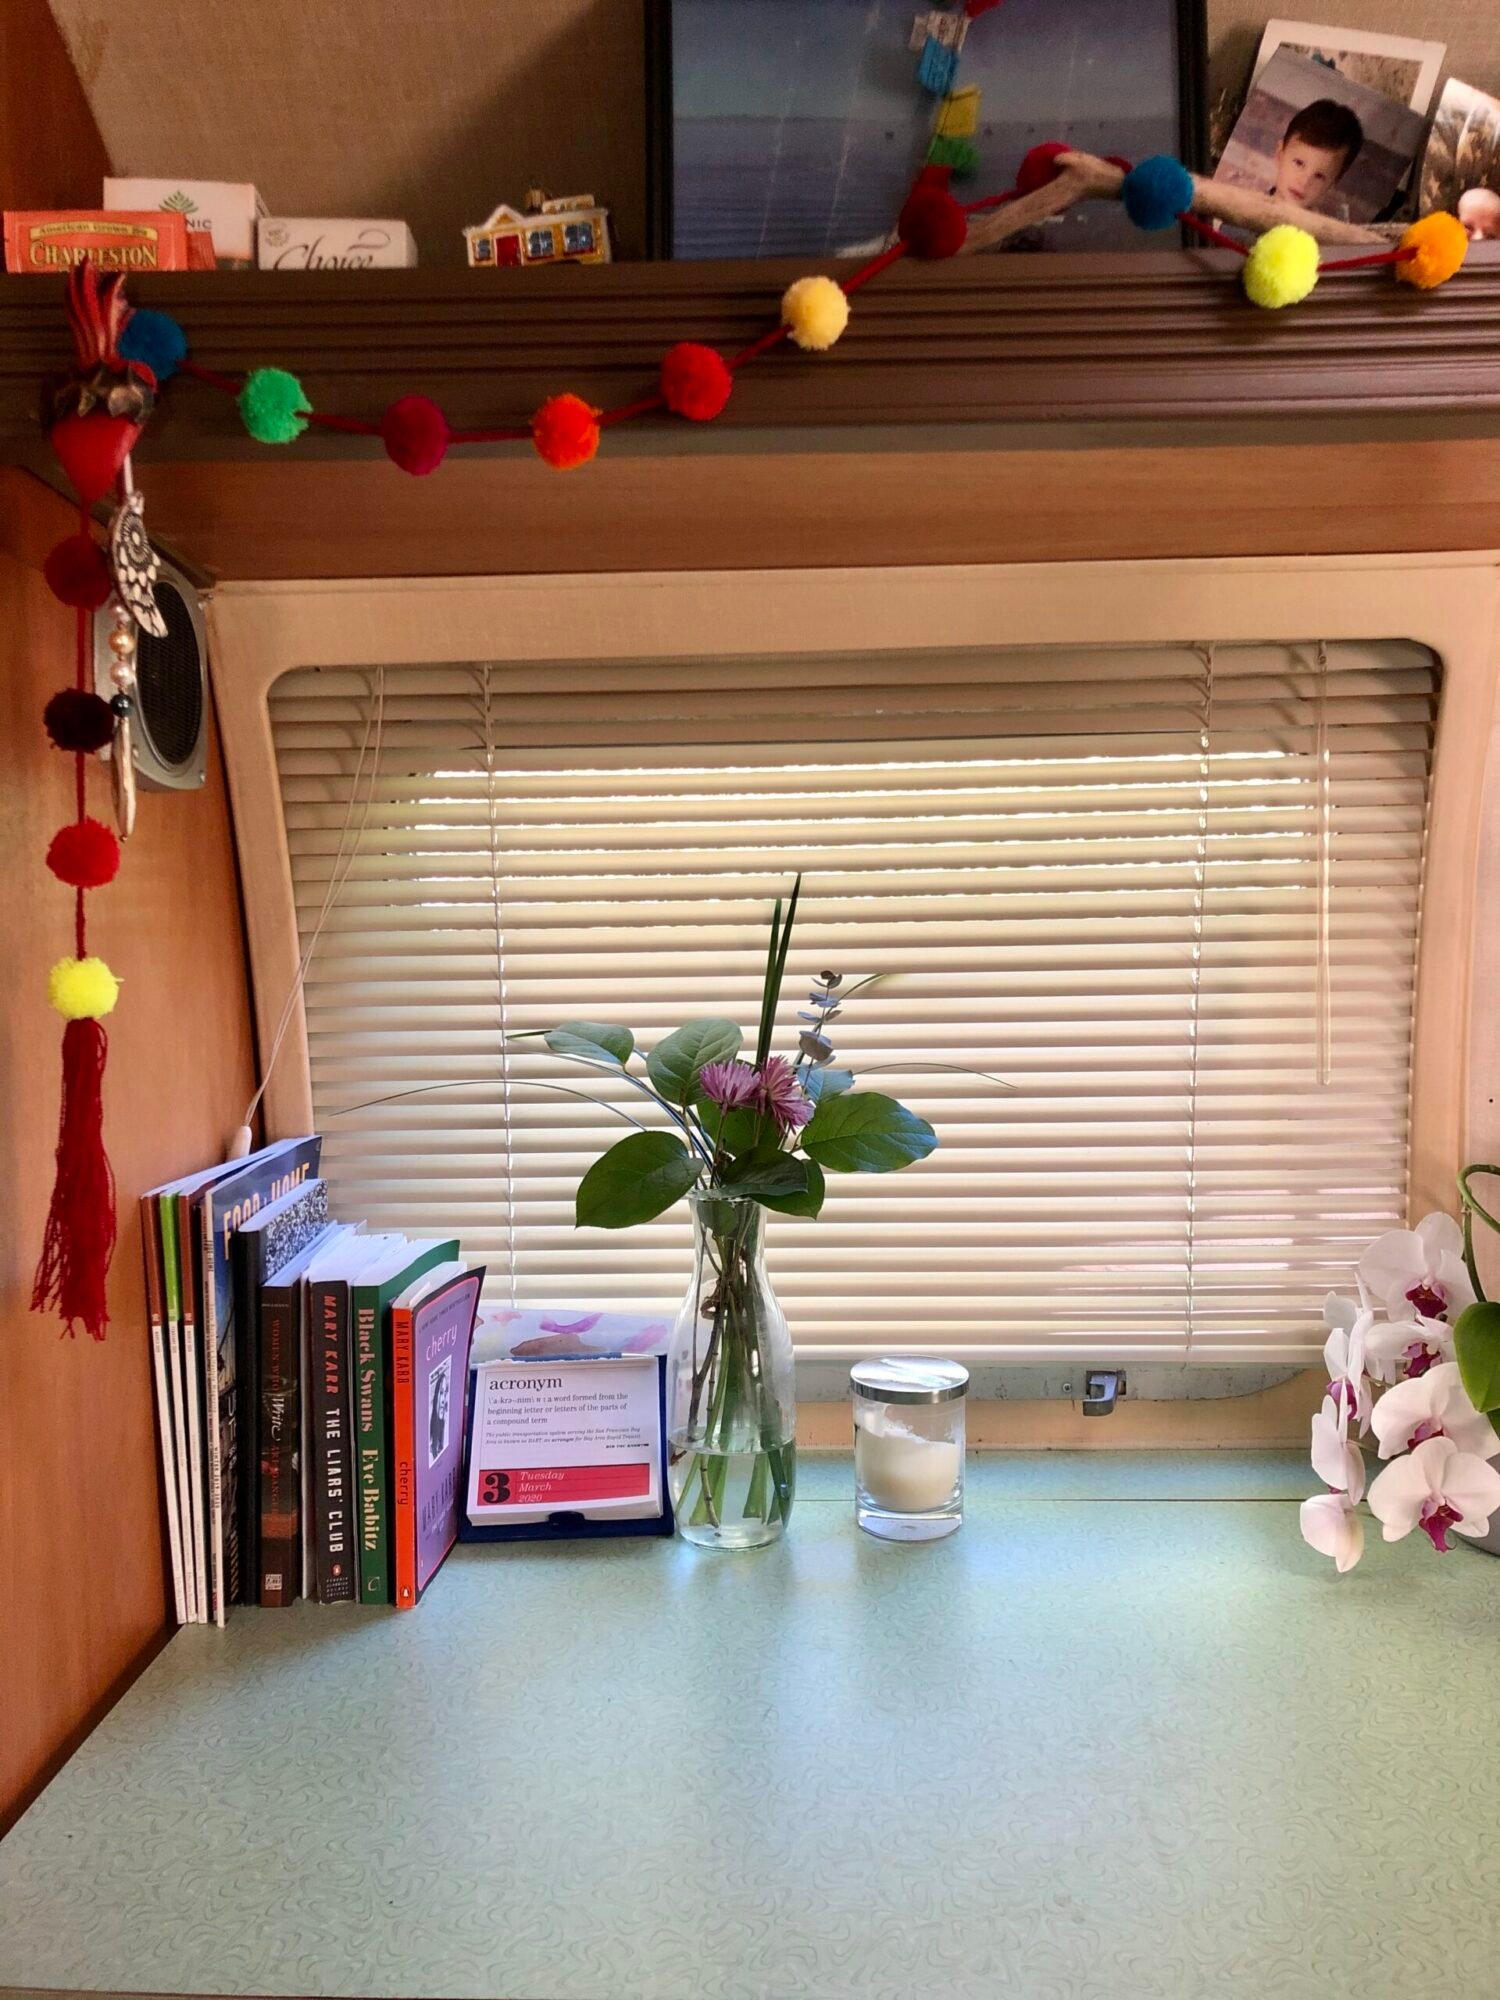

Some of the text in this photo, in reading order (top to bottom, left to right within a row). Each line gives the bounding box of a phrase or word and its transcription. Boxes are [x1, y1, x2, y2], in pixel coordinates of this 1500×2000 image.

[30, 240, 158, 268] CHARLESTON
[273, 229, 391, 270] Choice
[271, 1319, 280, 1361] WOMEN
[323, 1295, 339, 1394] MARY KARR
[395, 1321, 410, 1384] MARY KARR
[425, 1323, 458, 1361] cherry
[271, 1364, 280, 1392] WHO
[358, 1308, 376, 1432] Black Swans
[489, 1377, 563, 1392] acronym
[487, 1406, 523, 1416] beginning
[524, 1405, 543, 1414] letter
[554, 1404, 577, 1413] letters
[578, 1403, 586, 1412] of
[587, 1403, 599, 1412] the
[600, 1403, 618, 1413] parts
[619, 1402, 628, 1411] of
[553, 1394, 571, 1402] word
[572, 1393, 597, 1402] formed
[599, 1392, 615, 1401] from
[616, 1392, 628, 1400] the
[271, 1397, 285, 1441] Write
[492, 1416, 530, 1426] compound
[531, 1416, 548, 1424] term
[326, 1408, 344, 1553] THE LIARS' CLUB
[362, 1449, 380, 1551] Eve Babitz
[397, 1461, 412, 1505] cherry
[483, 1471, 565, 1504] 3 Tuesday
[518, 1494, 543, 1503] 2020
[519, 1482, 552, 1493] March
[422, 1488, 440, 1533] MARY
